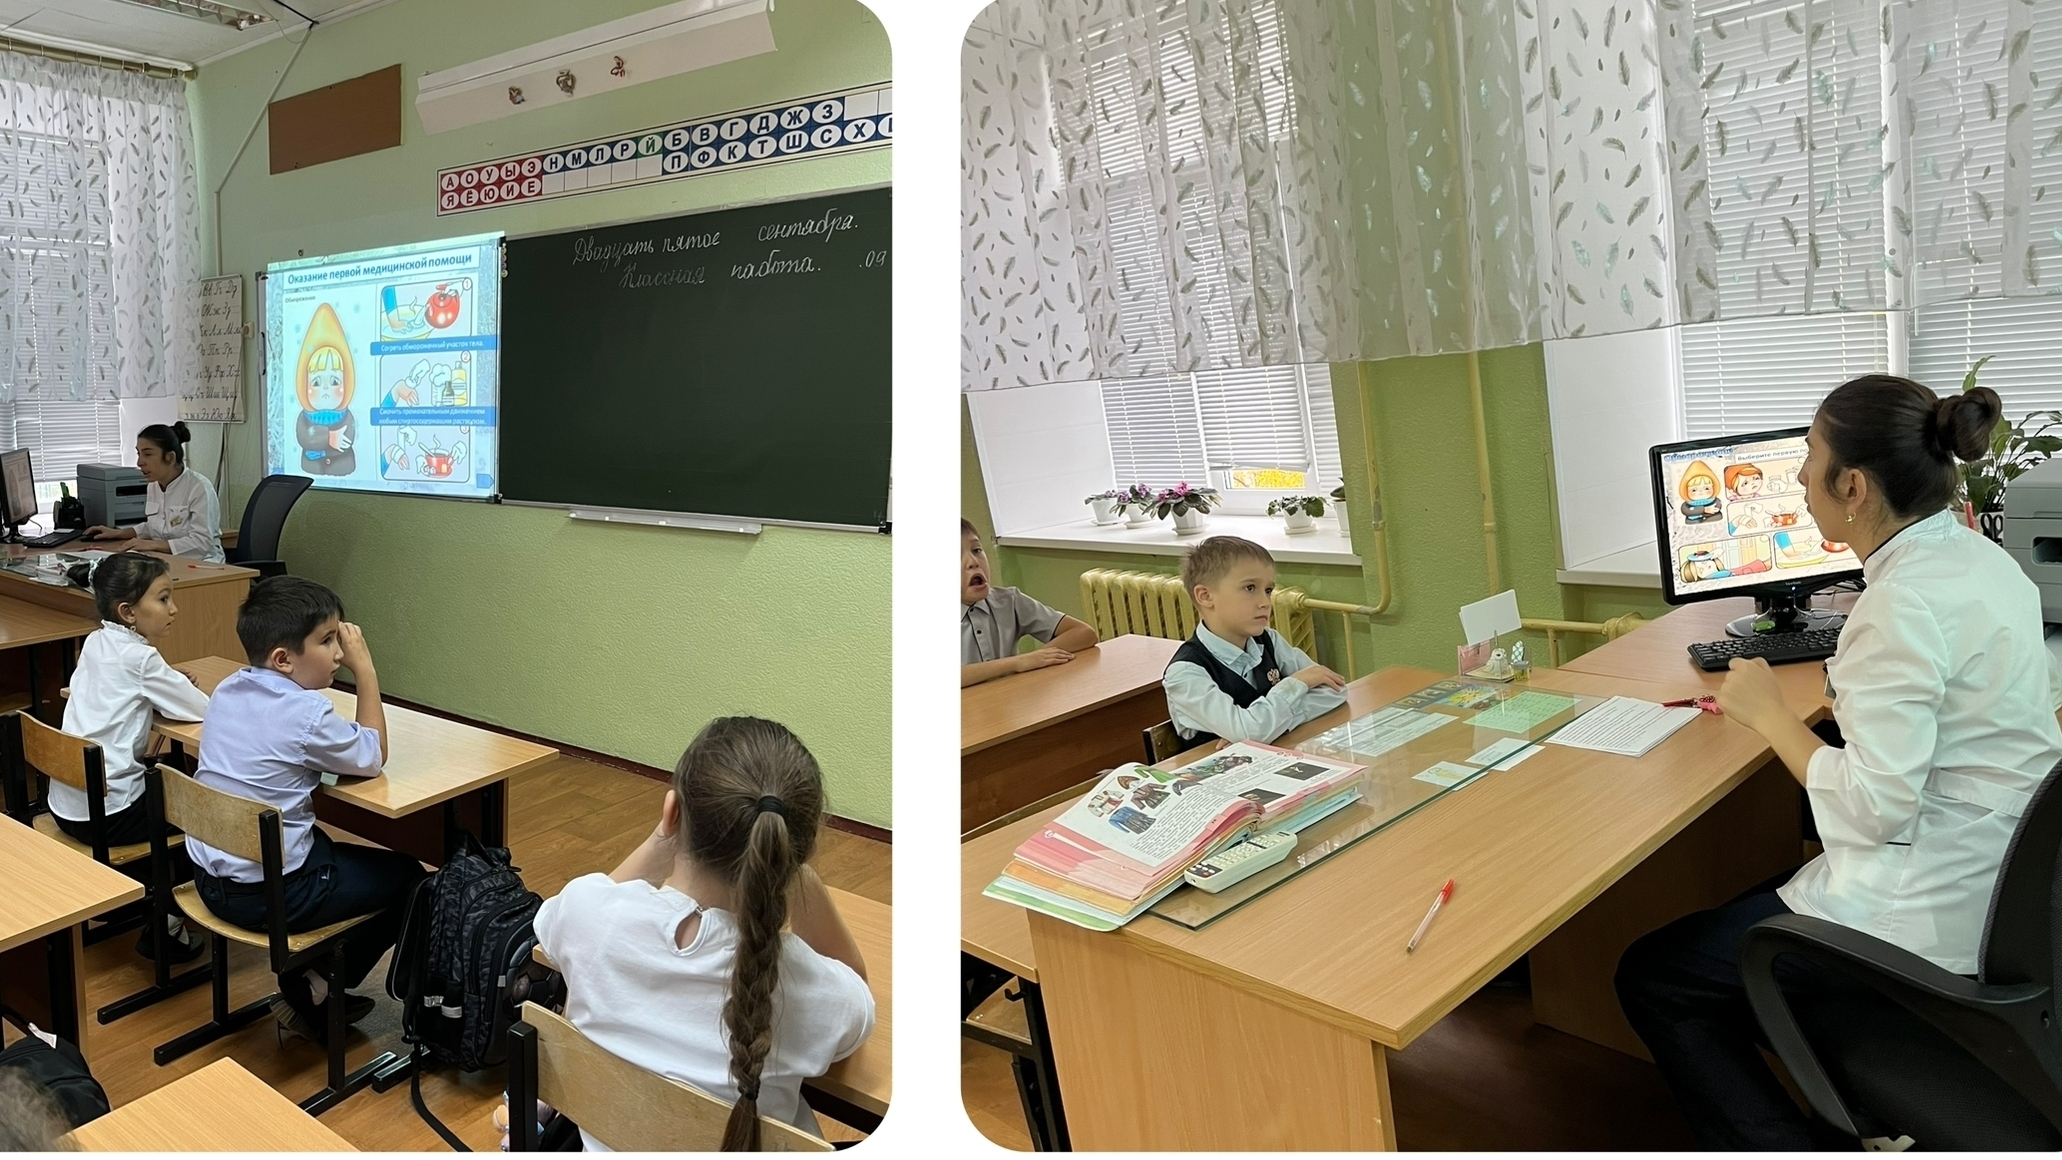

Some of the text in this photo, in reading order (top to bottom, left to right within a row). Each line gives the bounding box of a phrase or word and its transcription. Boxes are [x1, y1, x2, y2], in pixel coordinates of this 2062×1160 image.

[446, 104, 833, 189] А О У Ы Э Н М Л Р Й Б В Г Д Ж З
[671, 122, 867, 169] П Ф К Т Ш С Х
[446, 180, 535, 207] Я Ё Ю И Е
[288, 254, 472, 284] Оказание первой медицинской помощи
[572, 235, 654, 272] Двадцать
[662, 231, 721, 253] пятое
[618, 262, 706, 289] Классная
